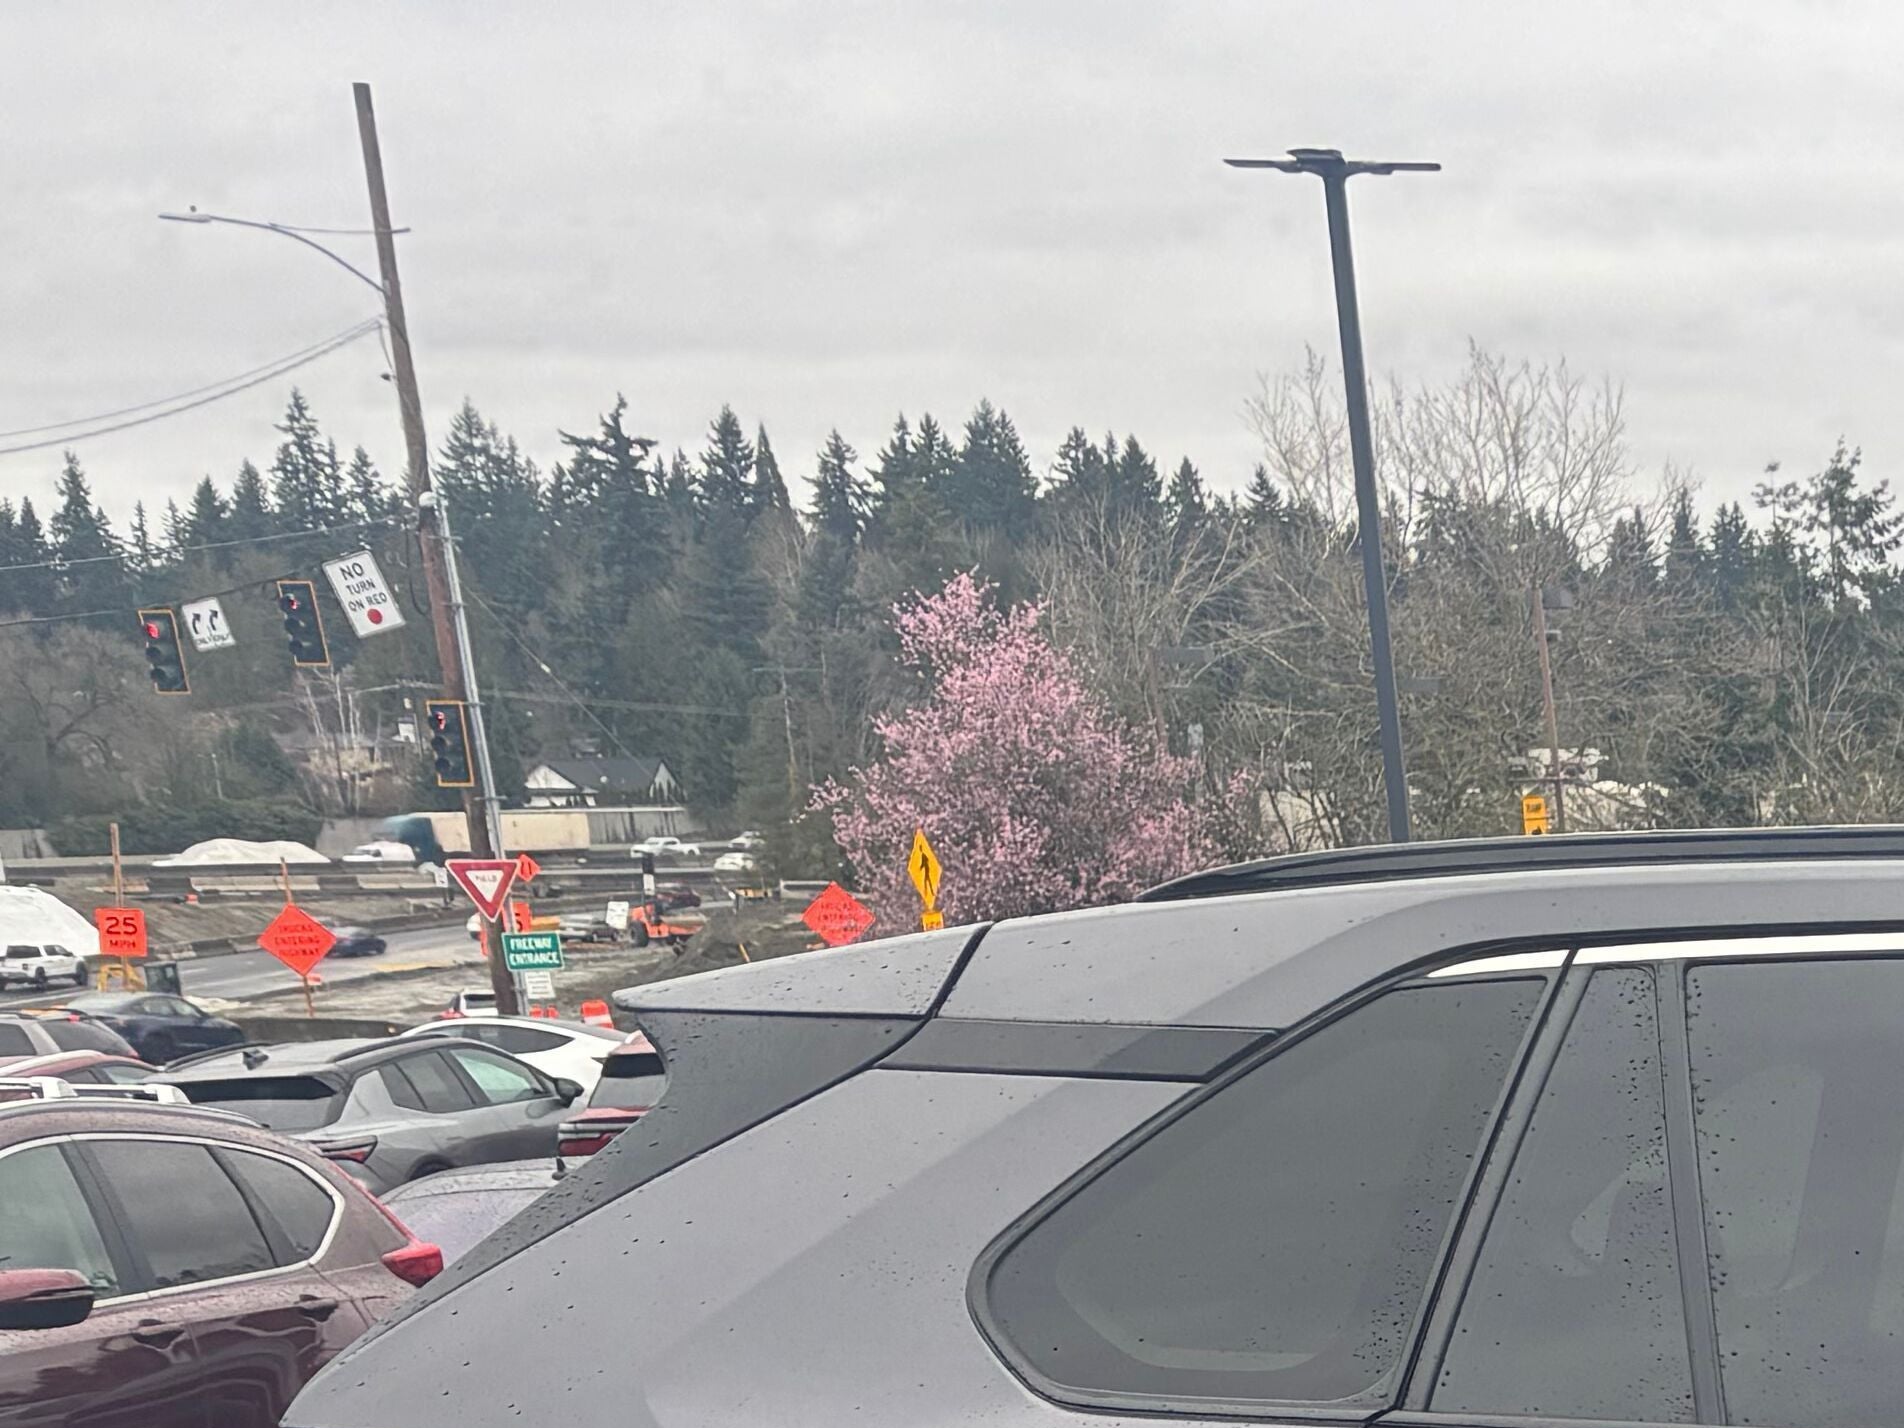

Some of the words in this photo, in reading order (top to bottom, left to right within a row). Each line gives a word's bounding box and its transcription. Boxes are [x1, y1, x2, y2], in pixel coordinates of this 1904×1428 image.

[340, 562, 364, 580] NO
[346, 578, 376, 595] TURN
[348, 599, 365, 611] ON
[366, 592, 387, 605] RED
[105, 916, 138, 935] 25
[510, 936, 552, 951] FREEWAY
[509, 952, 560, 966] ENTRANCE
